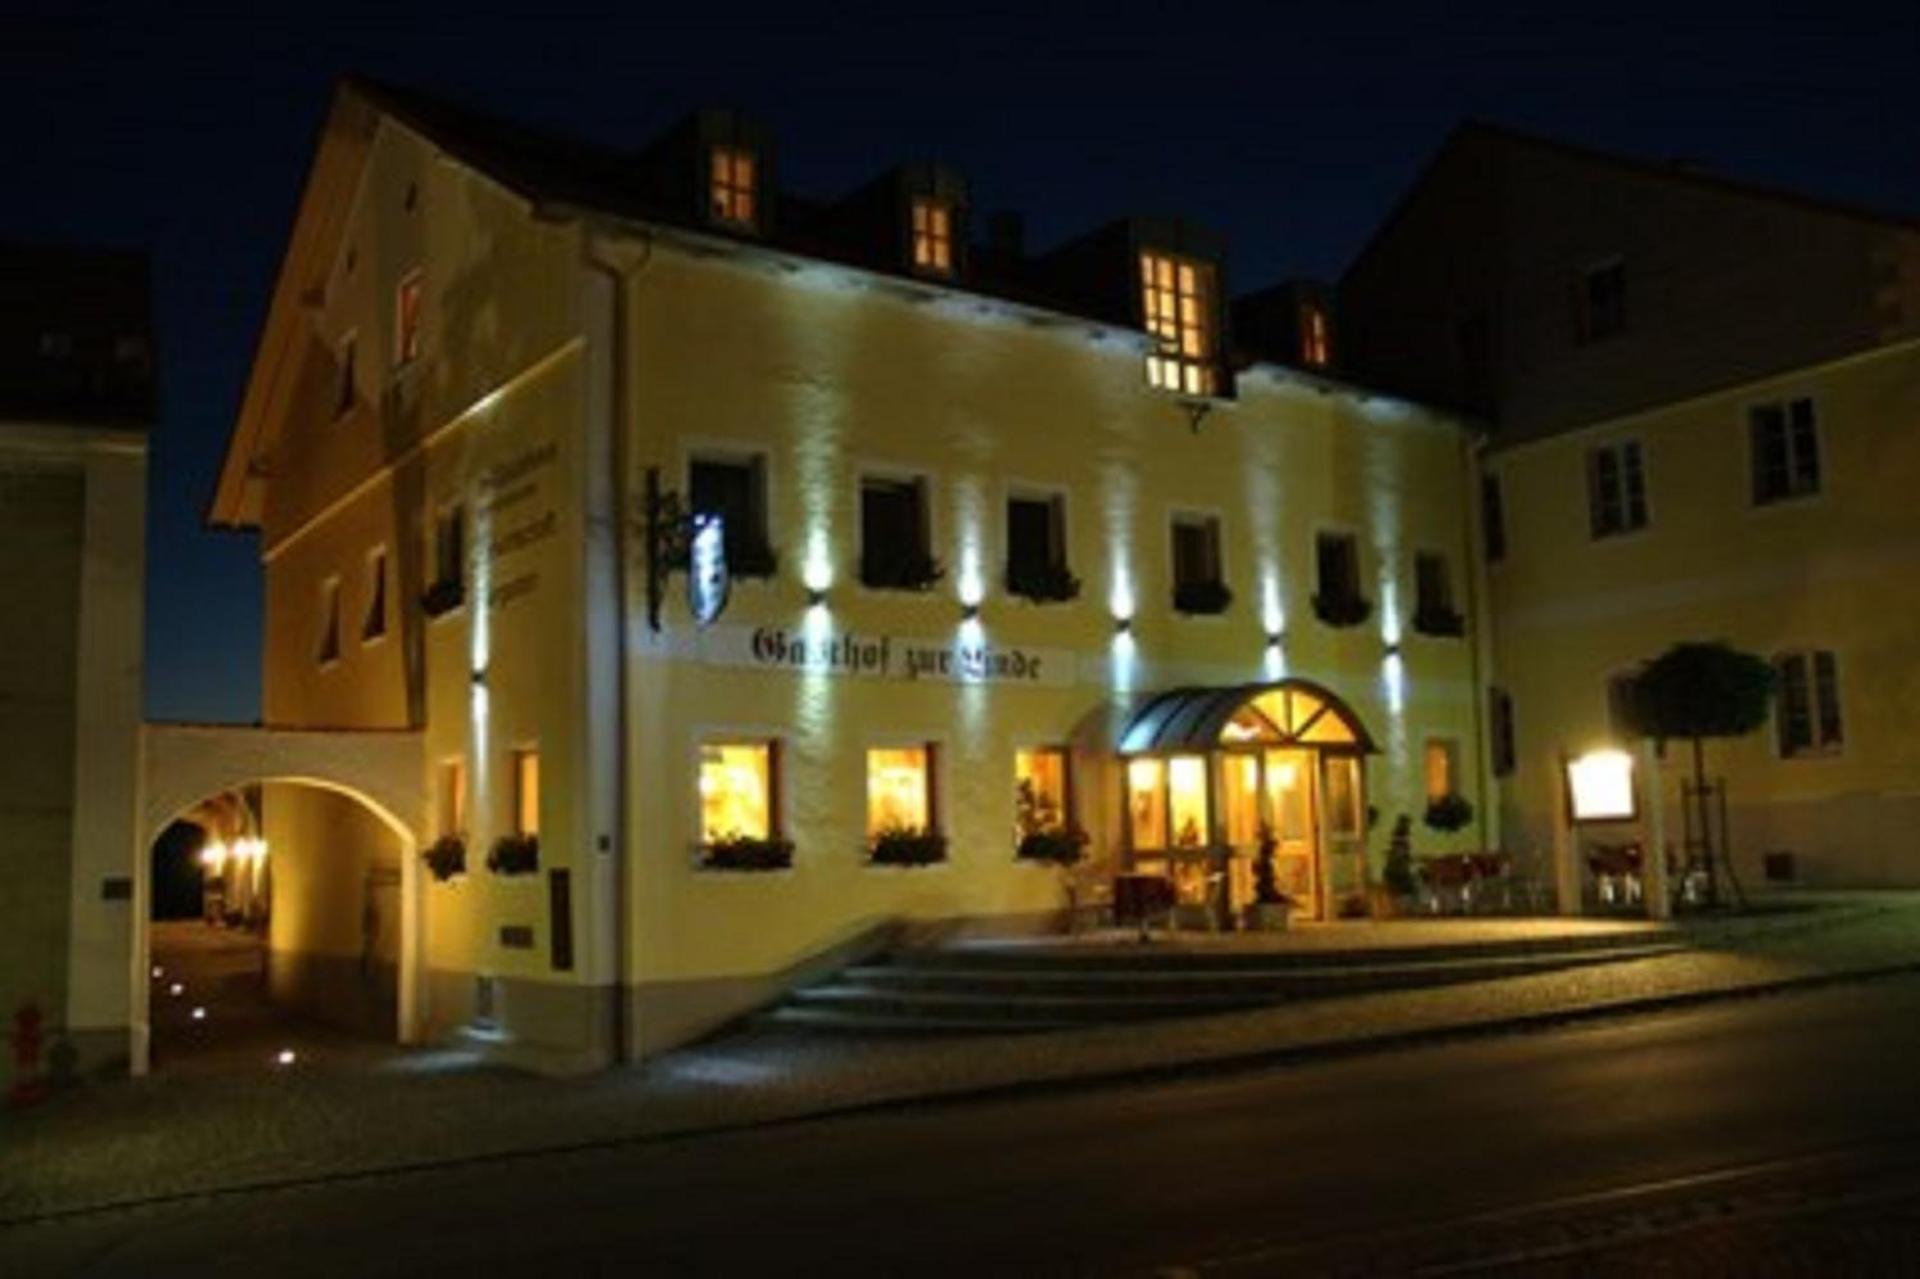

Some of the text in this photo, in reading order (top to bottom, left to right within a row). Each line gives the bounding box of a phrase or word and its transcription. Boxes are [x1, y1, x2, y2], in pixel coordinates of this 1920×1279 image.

[752, 627, 1042, 681] Gathof zur Linde
